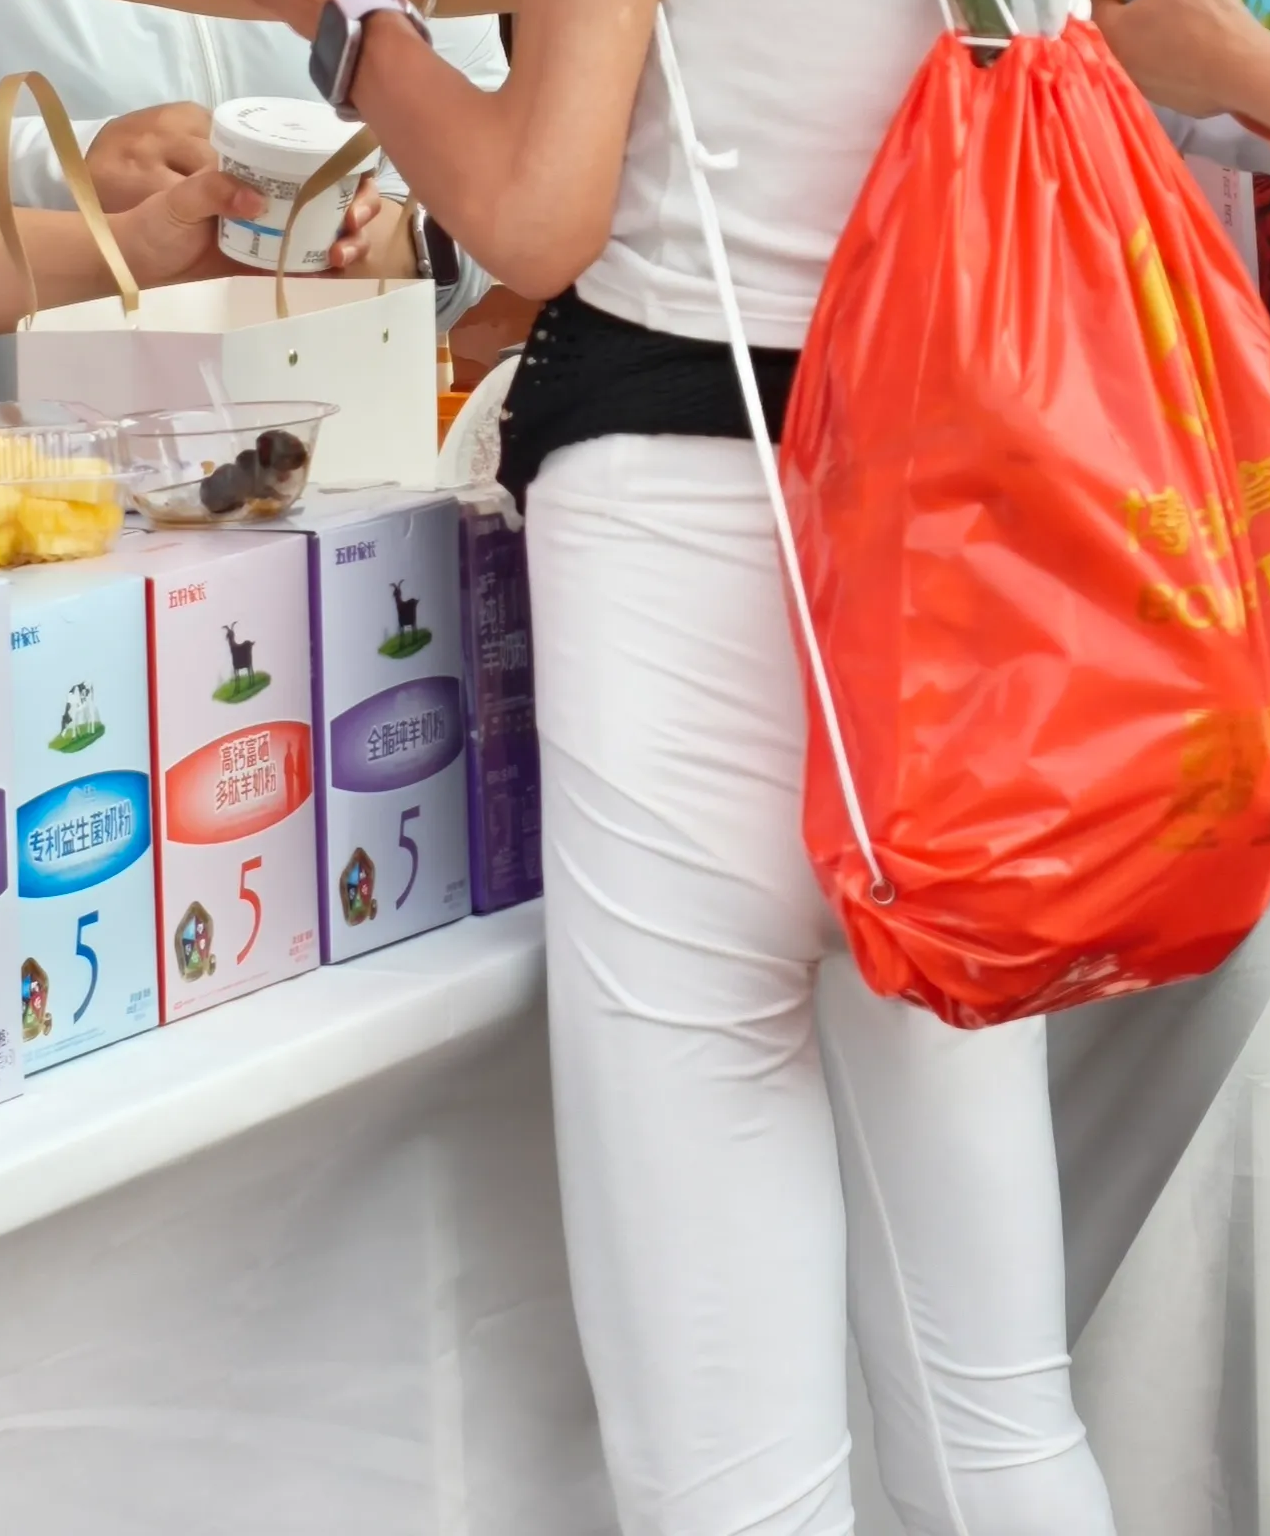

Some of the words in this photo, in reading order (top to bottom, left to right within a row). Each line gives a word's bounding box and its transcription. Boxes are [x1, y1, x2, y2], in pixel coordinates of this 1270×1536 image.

[29, 799, 133, 863] 专利益生菌奶粉
[395, 804, 422, 911] 5
[236, 855, 262, 966] 5
[73, 909, 99, 1025] 5
